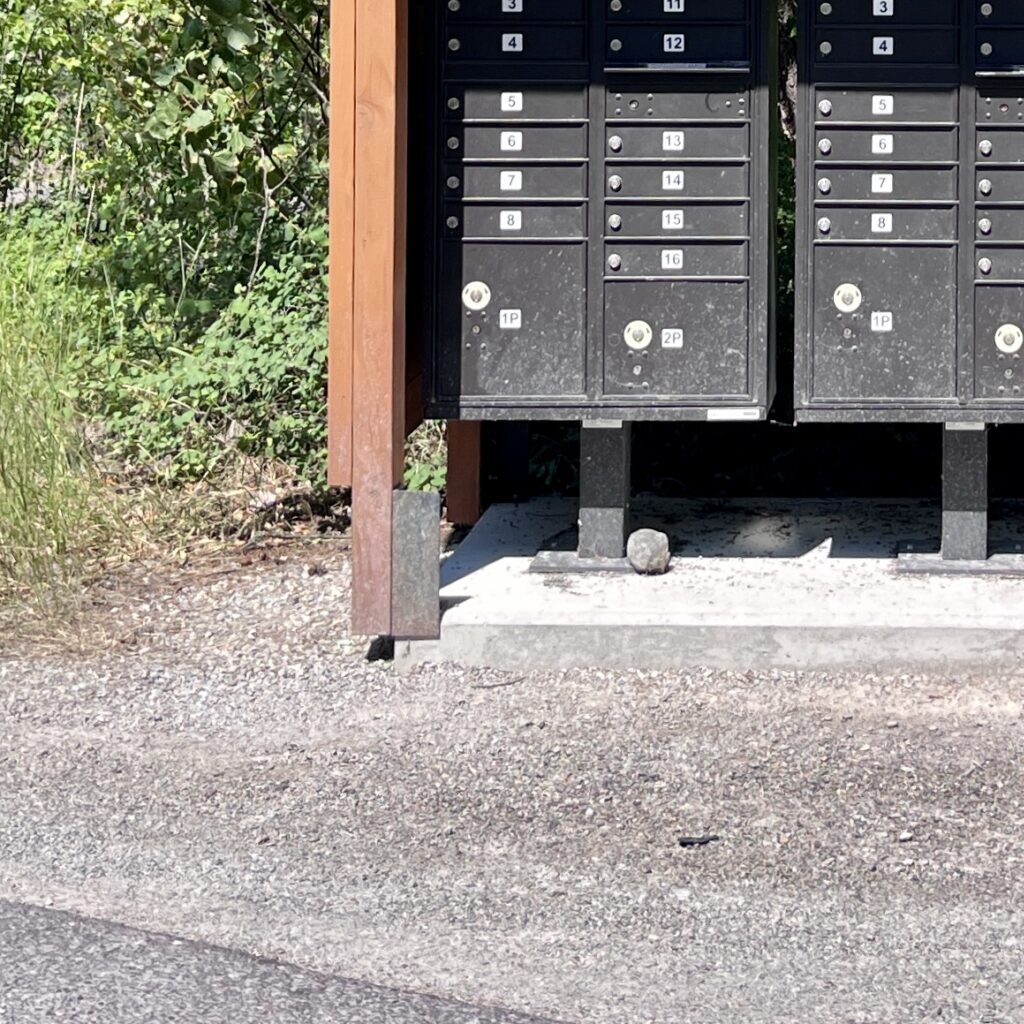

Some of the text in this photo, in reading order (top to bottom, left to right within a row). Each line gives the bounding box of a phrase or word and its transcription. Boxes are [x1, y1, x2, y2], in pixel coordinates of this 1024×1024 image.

[879, 1, 888, 14] 3
[507, 36, 517, 49] 4
[666, 37, 682, 50] 12
[878, 40, 888, 52] 4
[508, 95, 516, 108] 5
[878, 98, 887, 111] 5
[507, 135, 516, 148] 6
[665, 134, 682, 147] 13
[878, 138, 887, 150] 6
[507, 174, 516, 187] 7
[666, 174, 681, 186] 14
[879, 177, 887, 189] 7
[506, 214, 515, 227] 8
[664, 213, 681, 226] 15
[877, 216, 886, 229] 8
[664, 253, 681, 265] 16
[502, 312, 519, 324] 1P
[874, 315, 891, 327] 1P
[663, 331, 682, 344] 2P
